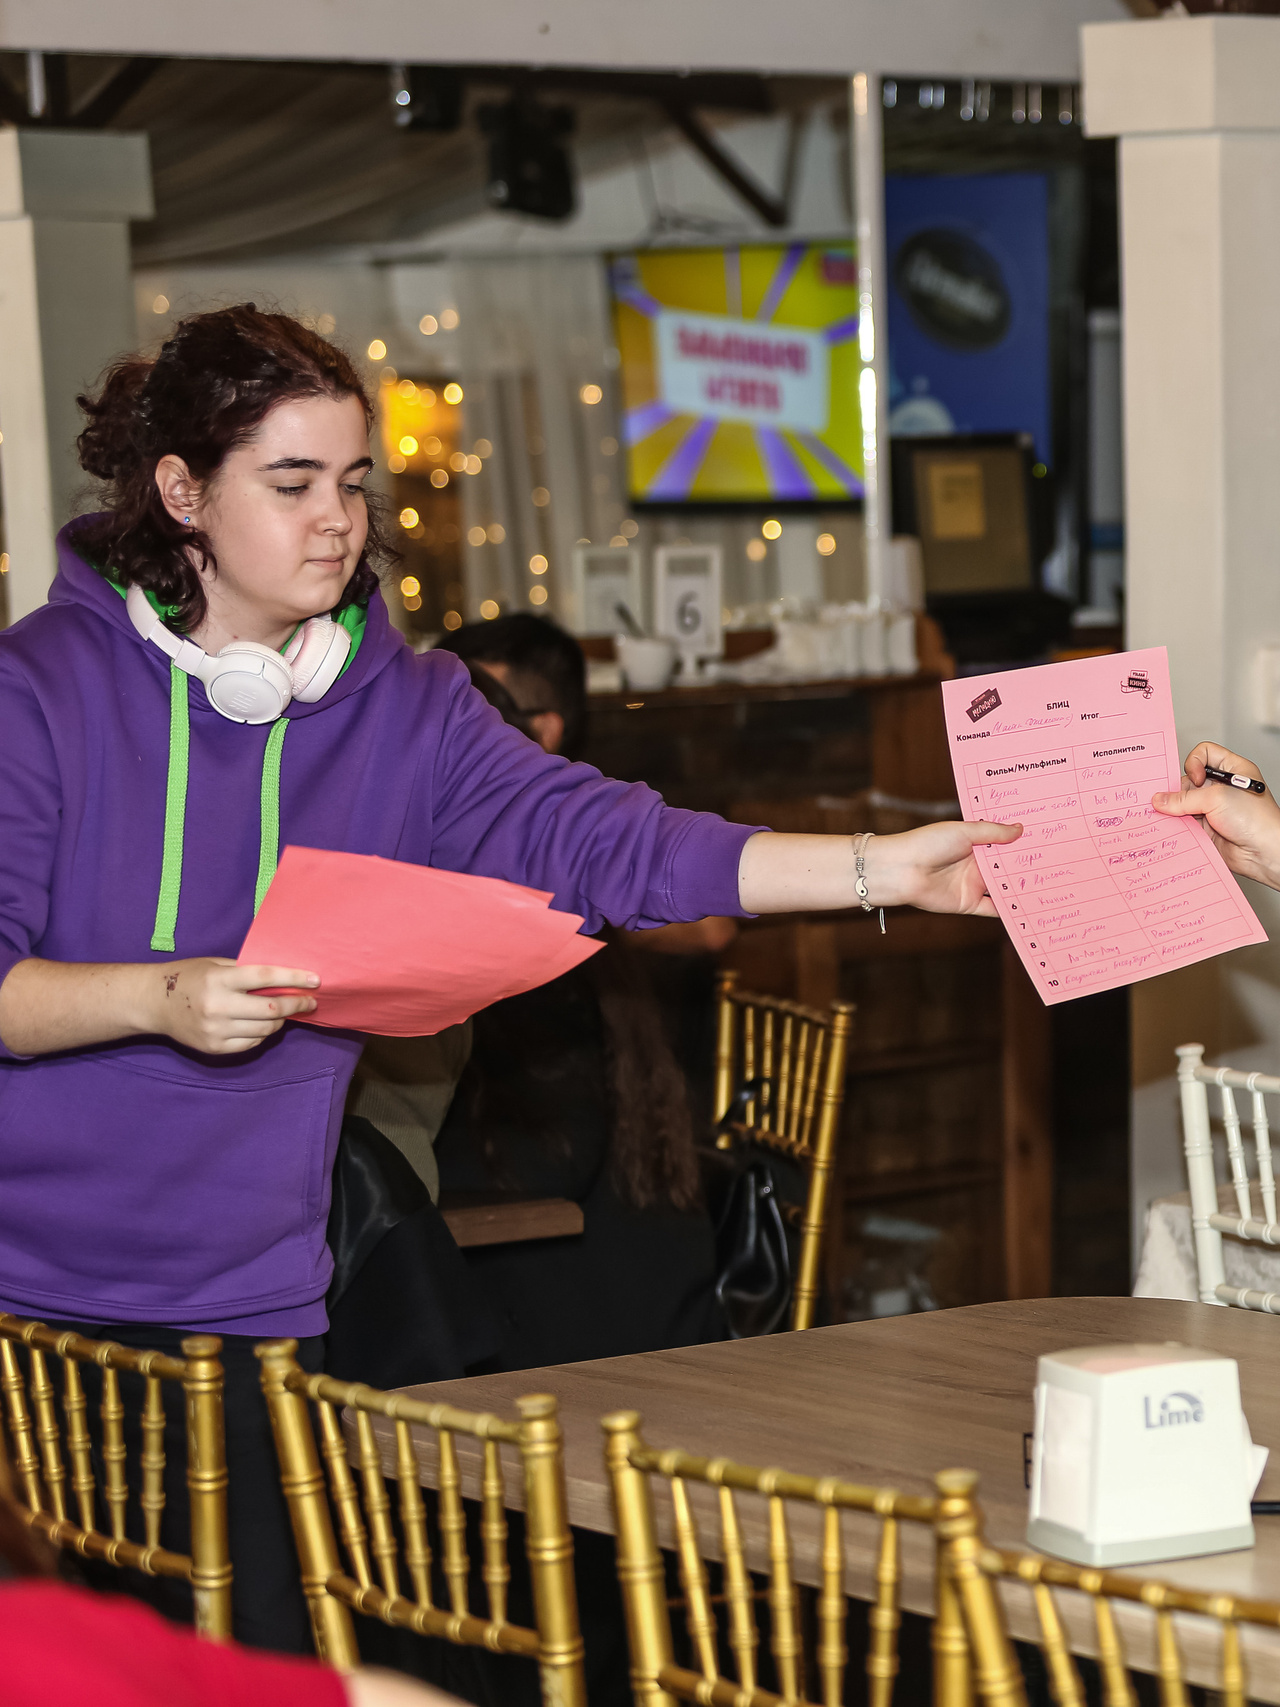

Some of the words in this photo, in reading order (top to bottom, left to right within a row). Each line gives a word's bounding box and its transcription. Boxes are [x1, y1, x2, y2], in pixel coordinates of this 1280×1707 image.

[676, 590, 701, 636] 6
[1129, 679, 1146, 688] КИНО
[1046, 700, 1070, 711] БЛИЦ
[1080, 712, 1100, 721] Итог
[956, 731, 991, 741] Команда
[1092, 744, 1146, 758] Исполнитель
[985, 757, 1067, 777] Фильм/Мульфильм
[974, 795, 979, 803] 1
[1020, 922, 1026, 930] 7
[1048, 979, 1059, 988] 10
[1144, 1395, 1204, 1430] Lime
